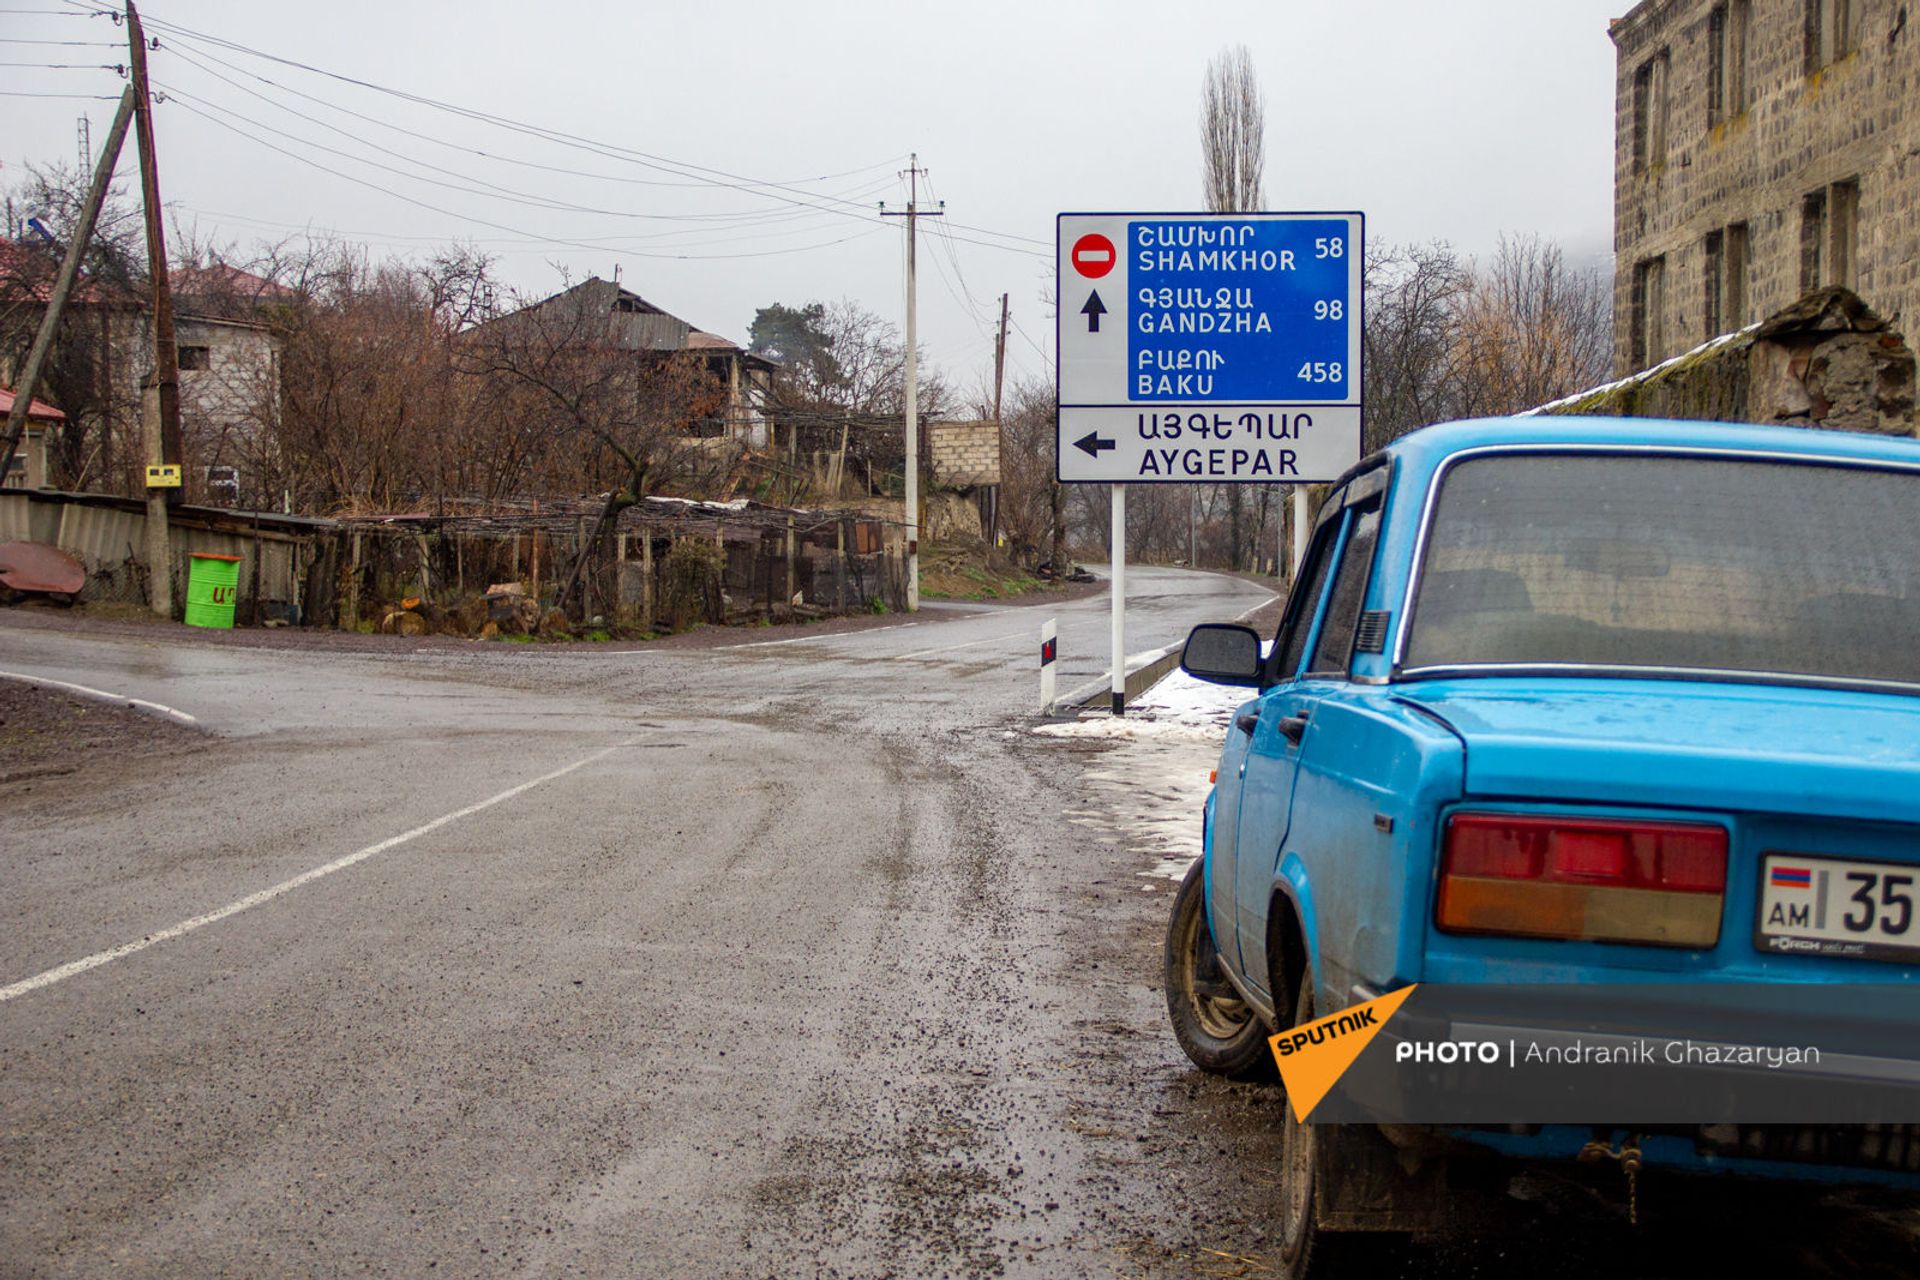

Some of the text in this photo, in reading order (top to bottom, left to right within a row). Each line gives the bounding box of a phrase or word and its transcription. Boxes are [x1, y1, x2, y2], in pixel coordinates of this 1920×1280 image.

[1139, 226, 1254, 246] ՇԱՄԽՈՐ
[1316, 237, 1343, 258] 58
[1140, 250, 1295, 270] SHAMKHOR
[1139, 288, 1253, 309] ԳՅԱՆՋԱ
[1315, 300, 1342, 320] 98
[1139, 313, 1271, 332] GANDZHA
[1139, 350, 1224, 370] ԲԱՔՈՒ
[1298, 363, 1342, 382] 458
[1139, 375, 1212, 394] BAKU
[1139, 413, 1312, 439] ԱՅԳԵՊԱՐ
[1139, 449, 1298, 475] AYGEPAR
[1768, 872, 1913, 935] AM 35
